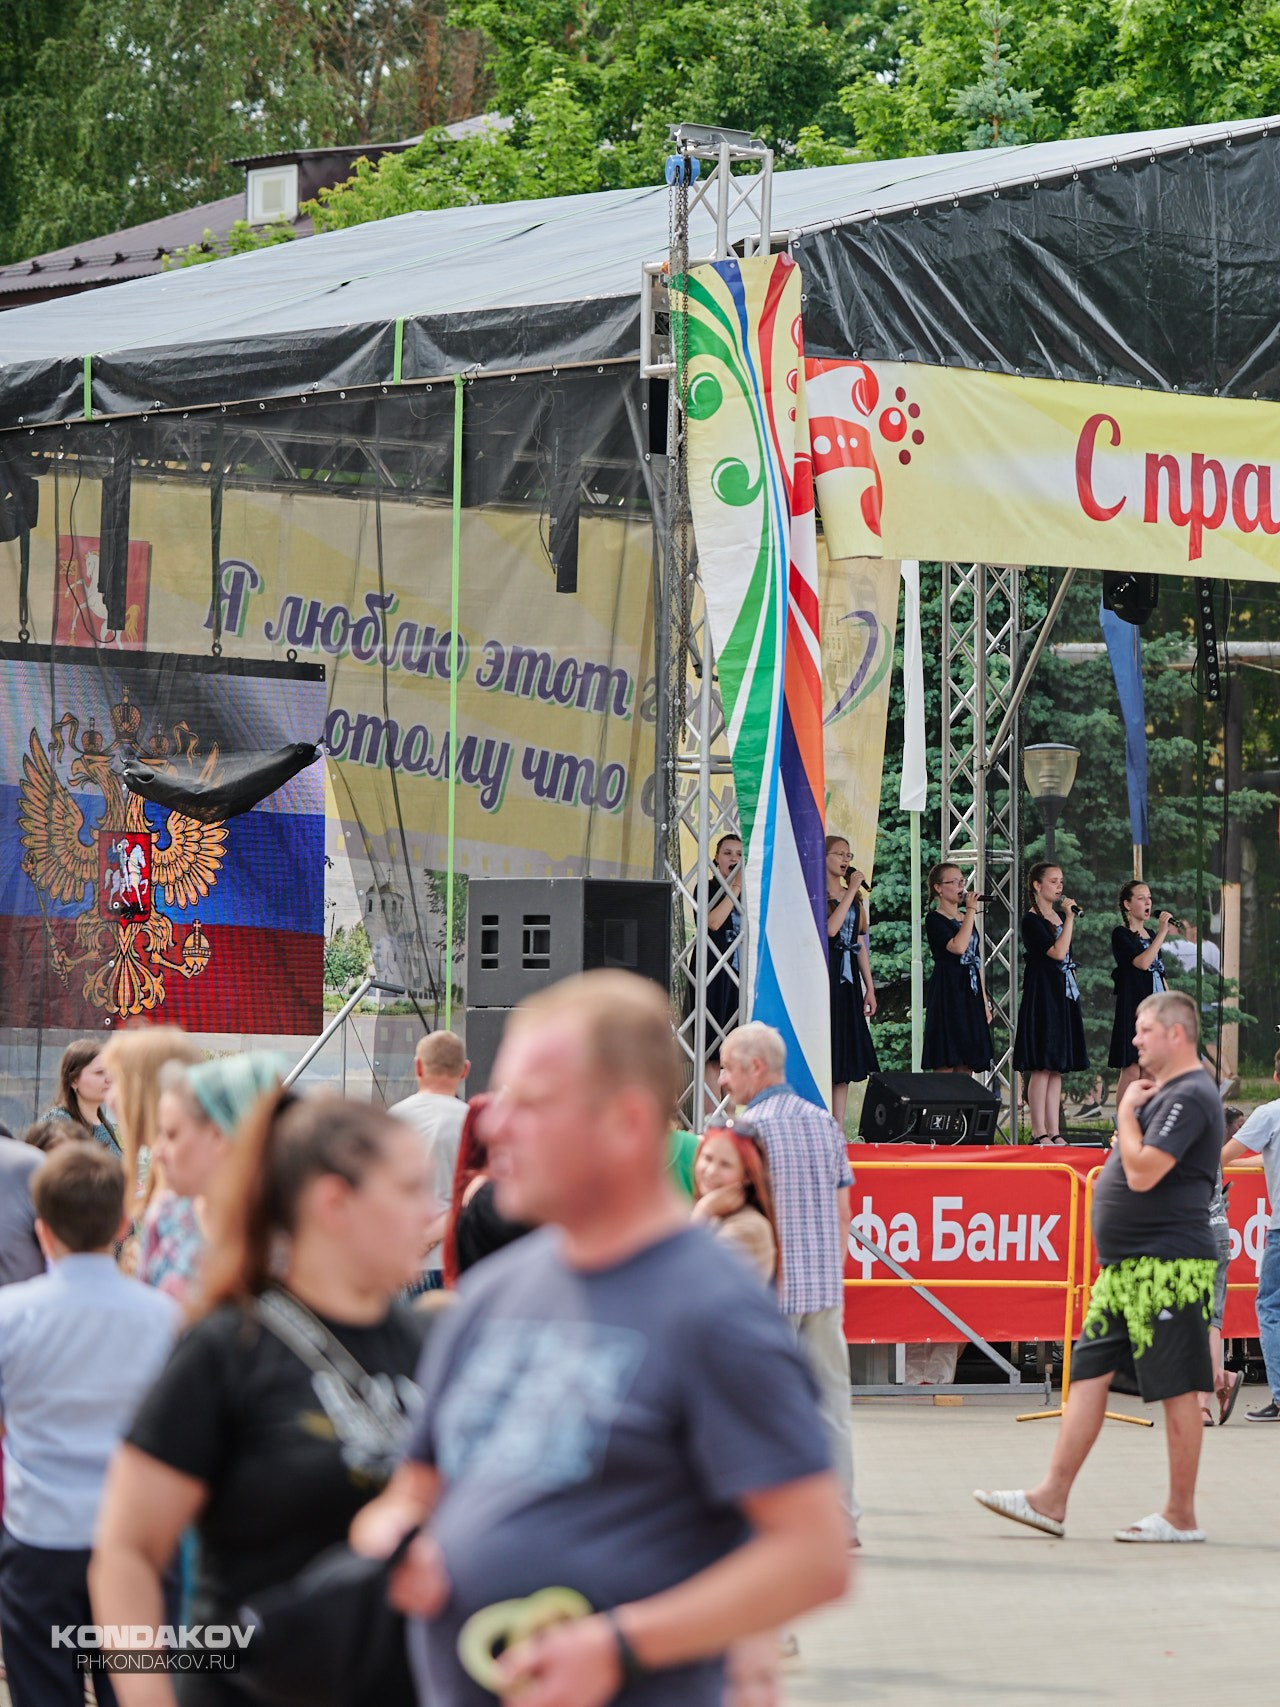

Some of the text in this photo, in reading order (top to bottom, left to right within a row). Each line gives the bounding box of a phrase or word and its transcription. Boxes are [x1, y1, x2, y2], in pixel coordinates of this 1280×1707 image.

[1075, 413, 1127, 522] С
[203, 559, 264, 636] Я
[264, 592, 466, 680] люблю
[476, 639, 633, 718] этот
[324, 708, 512, 812] отому
[521, 744, 628, 812] что
[848, 1196, 1062, 1280] фа Банк
